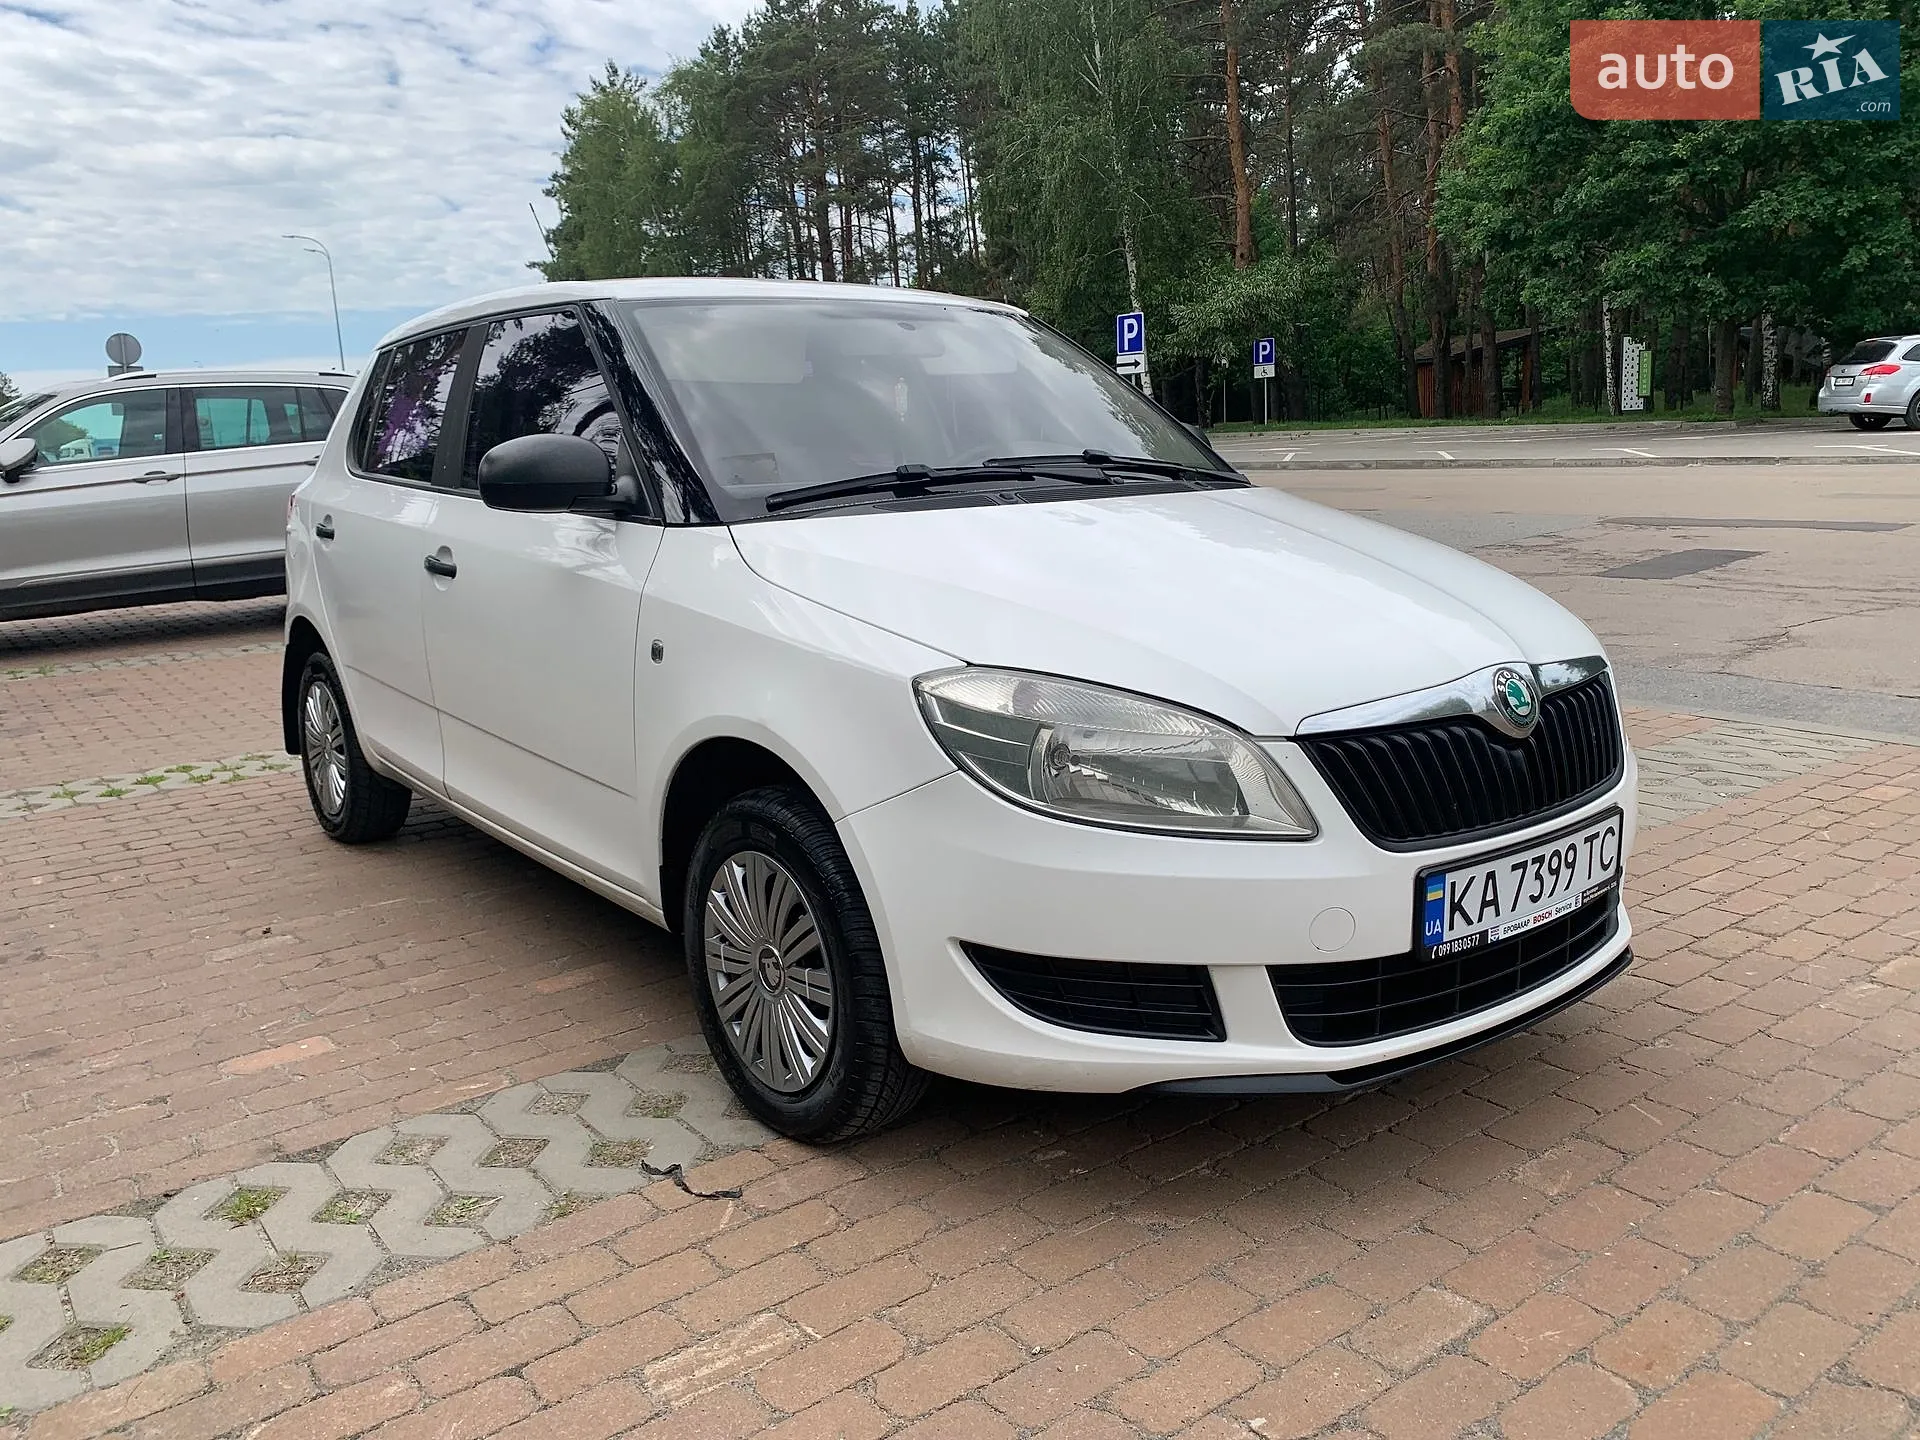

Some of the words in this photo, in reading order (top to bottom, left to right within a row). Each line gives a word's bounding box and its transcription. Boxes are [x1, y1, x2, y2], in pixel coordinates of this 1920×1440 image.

[1124, 318, 1138, 351] P
[1259, 341, 1271, 363] P
[1448, 869, 1501, 931] KA
[1511, 842, 1577, 913] 7399
[1584, 826, 1616, 880] TC
[1532, 910, 1552, 924] BOSCH
[1554, 902, 1573, 915] Service
[1425, 919, 1442, 936] UA
